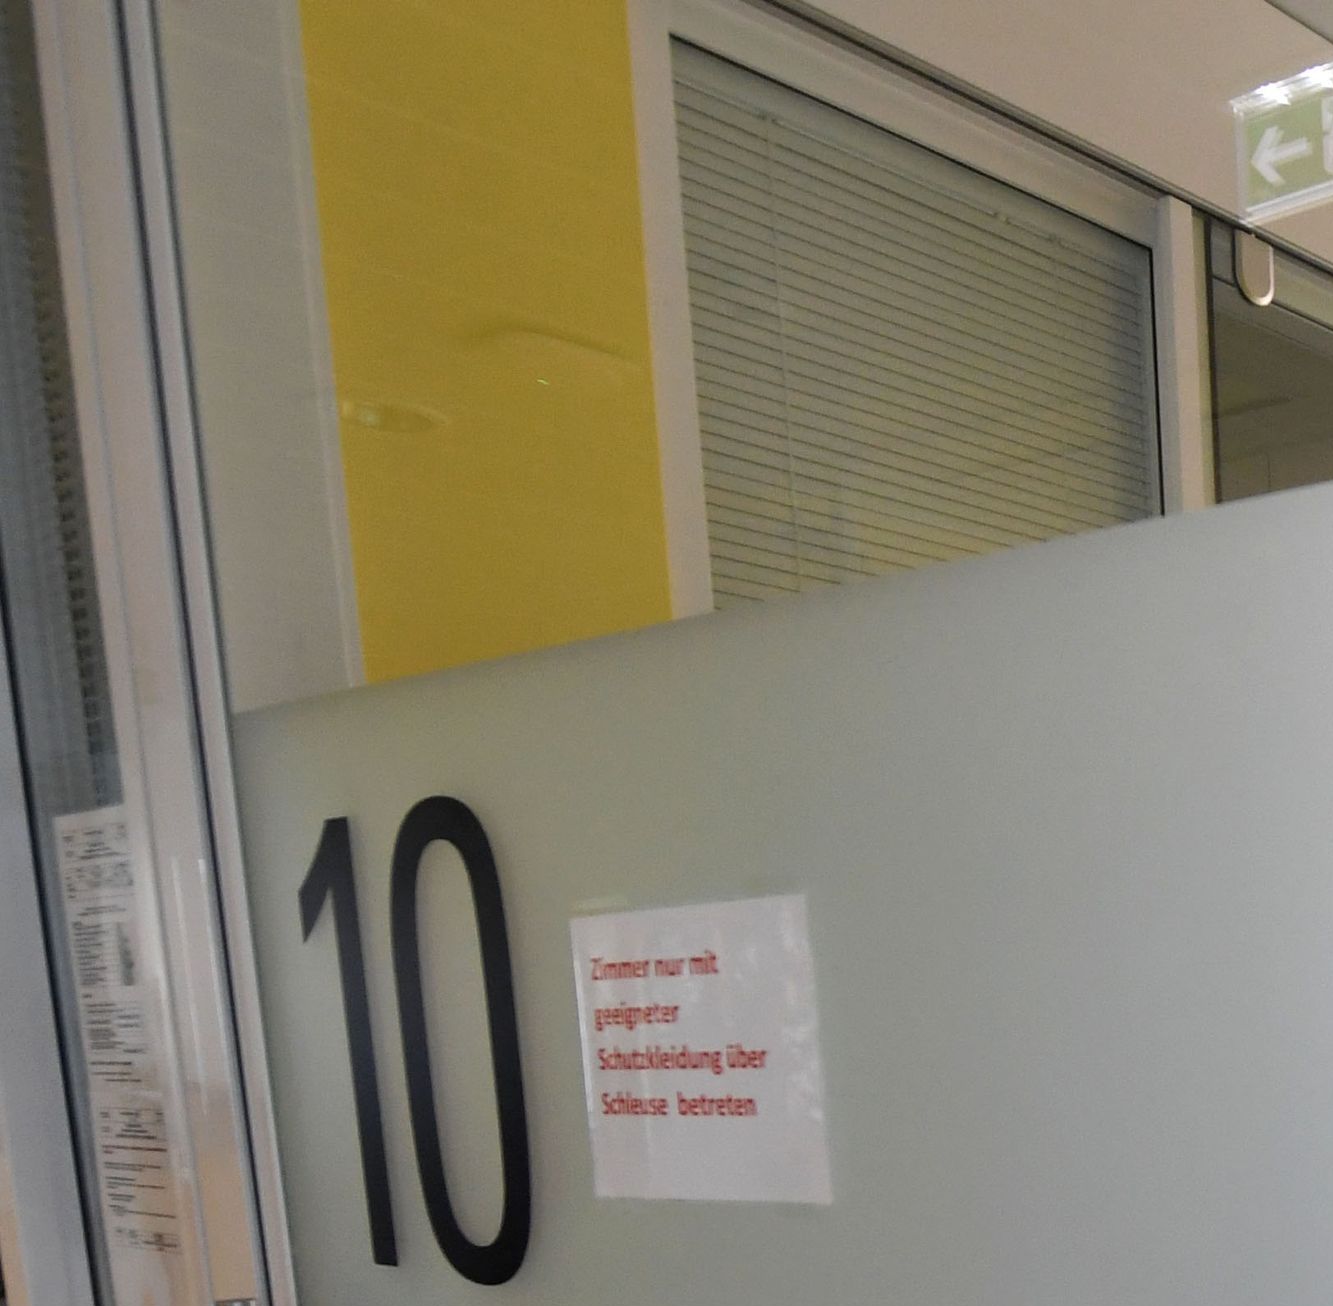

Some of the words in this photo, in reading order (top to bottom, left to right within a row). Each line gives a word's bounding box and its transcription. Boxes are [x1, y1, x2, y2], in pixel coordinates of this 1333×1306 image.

[591, 957, 650, 981] Zimmer
[653, 959, 685, 976] nur
[689, 950, 719, 976] mit
[593, 1002, 679, 1032] geeigneter
[299, 796, 532, 1287] 10
[596, 1045, 723, 1075] Schutzkleidung
[725, 1043, 767, 1069] über
[601, 1091, 669, 1116] Schleuse
[676, 1091, 757, 1116] betreten
